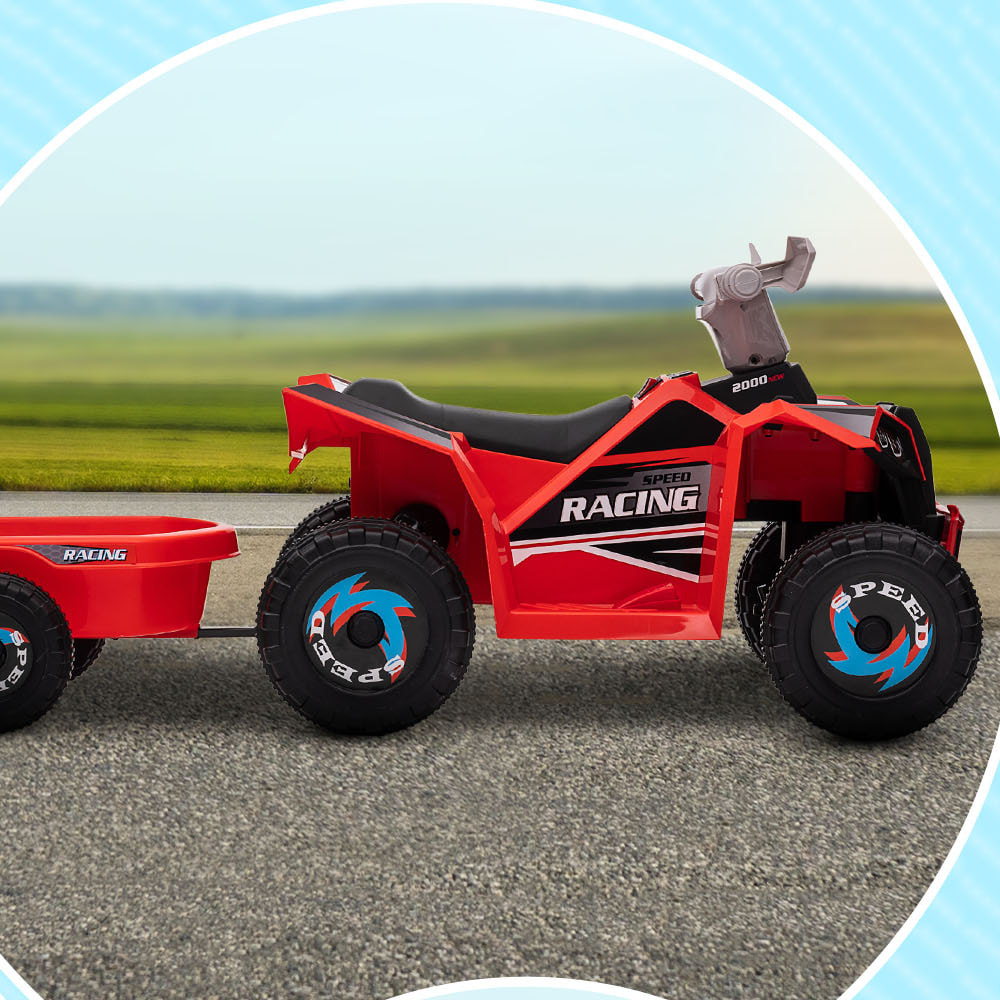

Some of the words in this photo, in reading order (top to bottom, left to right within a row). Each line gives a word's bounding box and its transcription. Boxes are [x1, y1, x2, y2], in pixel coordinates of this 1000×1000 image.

[732, 374, 768, 393] 2000
[642, 471, 692, 486] SPEED
[560, 485, 700, 523] RACING
[63, 548, 128, 562] RACING
[831, 580, 929, 649] SPEED
[310, 610, 405, 683] SPEED
